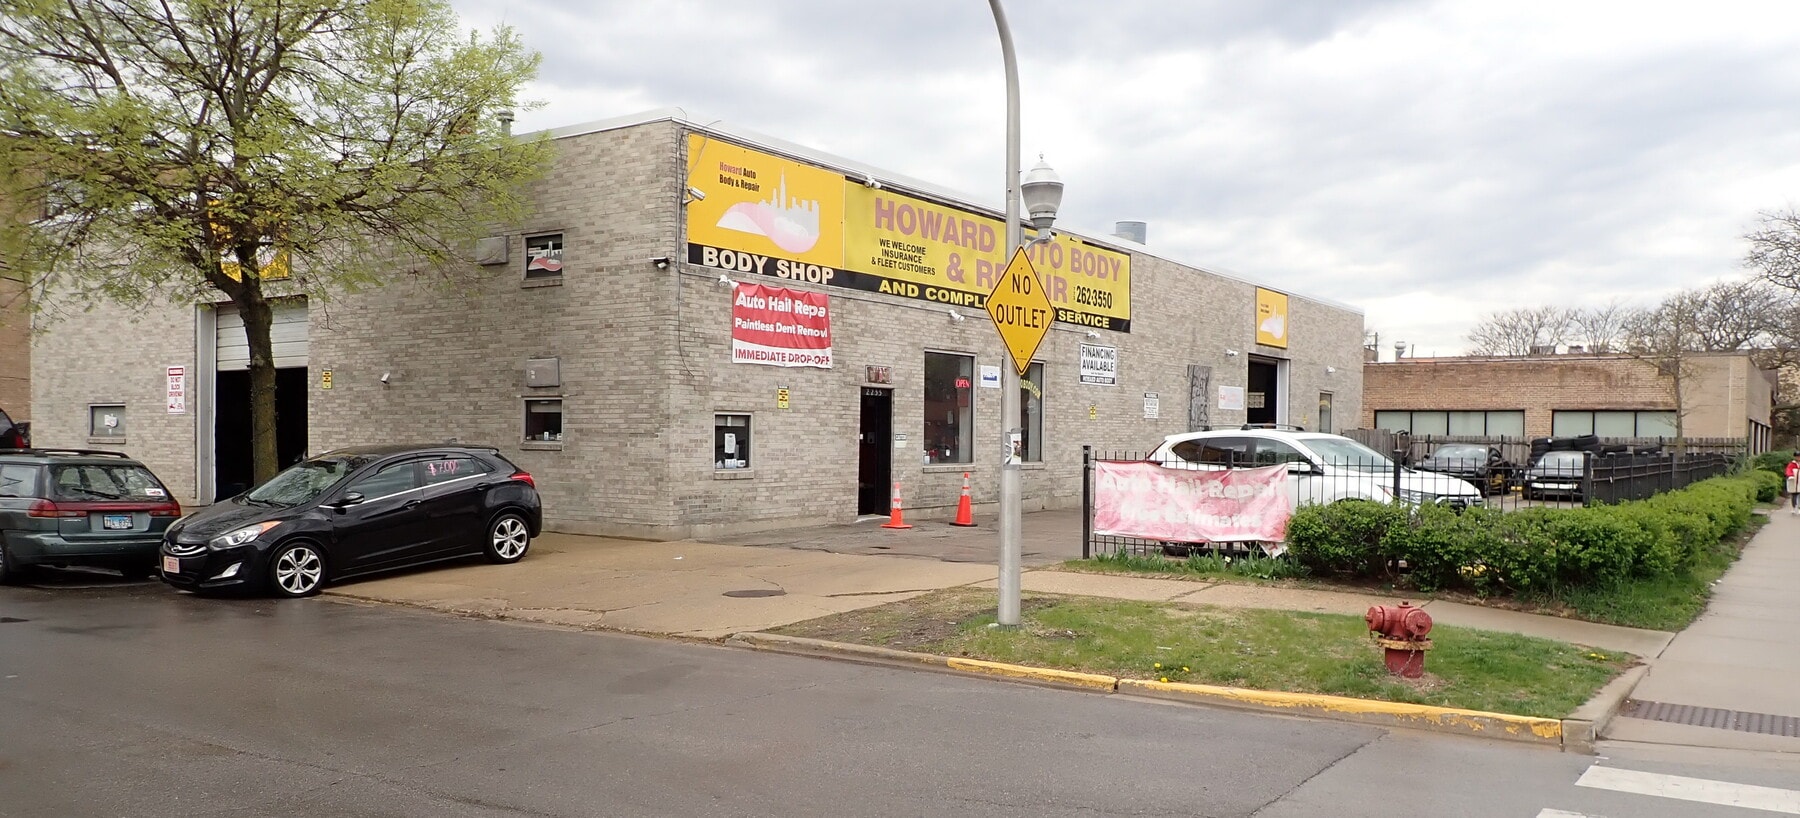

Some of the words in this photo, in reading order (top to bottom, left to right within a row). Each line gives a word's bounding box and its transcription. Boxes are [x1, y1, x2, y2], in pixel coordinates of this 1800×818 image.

[719, 161, 742, 176] Howard
[742, 167, 757, 180] Auto
[719, 174, 735, 187] Body
[735, 178, 740, 188] &
[740, 180, 760, 193] Repair
[875, 197, 996, 253] HOWARD
[1027, 240, 1063, 269] TO
[1070, 248, 1121, 282] BODY
[879, 238, 891, 248] WE
[891, 240, 926, 256] WELCOME
[702, 246, 769, 274] BODY
[776, 259, 834, 285] SHOP
[881, 248, 922, 264] INSURANCE
[871, 256, 877, 266] &
[877, 257, 897, 269] FLEET
[898, 261, 936, 276] CUSTOMERS
[946, 252, 966, 284] &
[976, 258, 1068, 304] REIR
[1012, 272, 1031, 295] NO
[735, 291, 766, 310] Auto
[768, 296, 792, 313] Hail
[878, 279, 919, 298] AND
[1058, 310, 1110, 328] SERVICE
[734, 317, 775, 332] Paintless
[775, 322, 796, 334] Dent
[996, 303, 1046, 329] OUTLET
[735, 348, 786, 363] IMMEDIATE
[1081, 346, 1115, 360] FINANCING
[1081, 359, 1114, 372] AVAILABLE
[955, 379, 970, 388] OPEN
